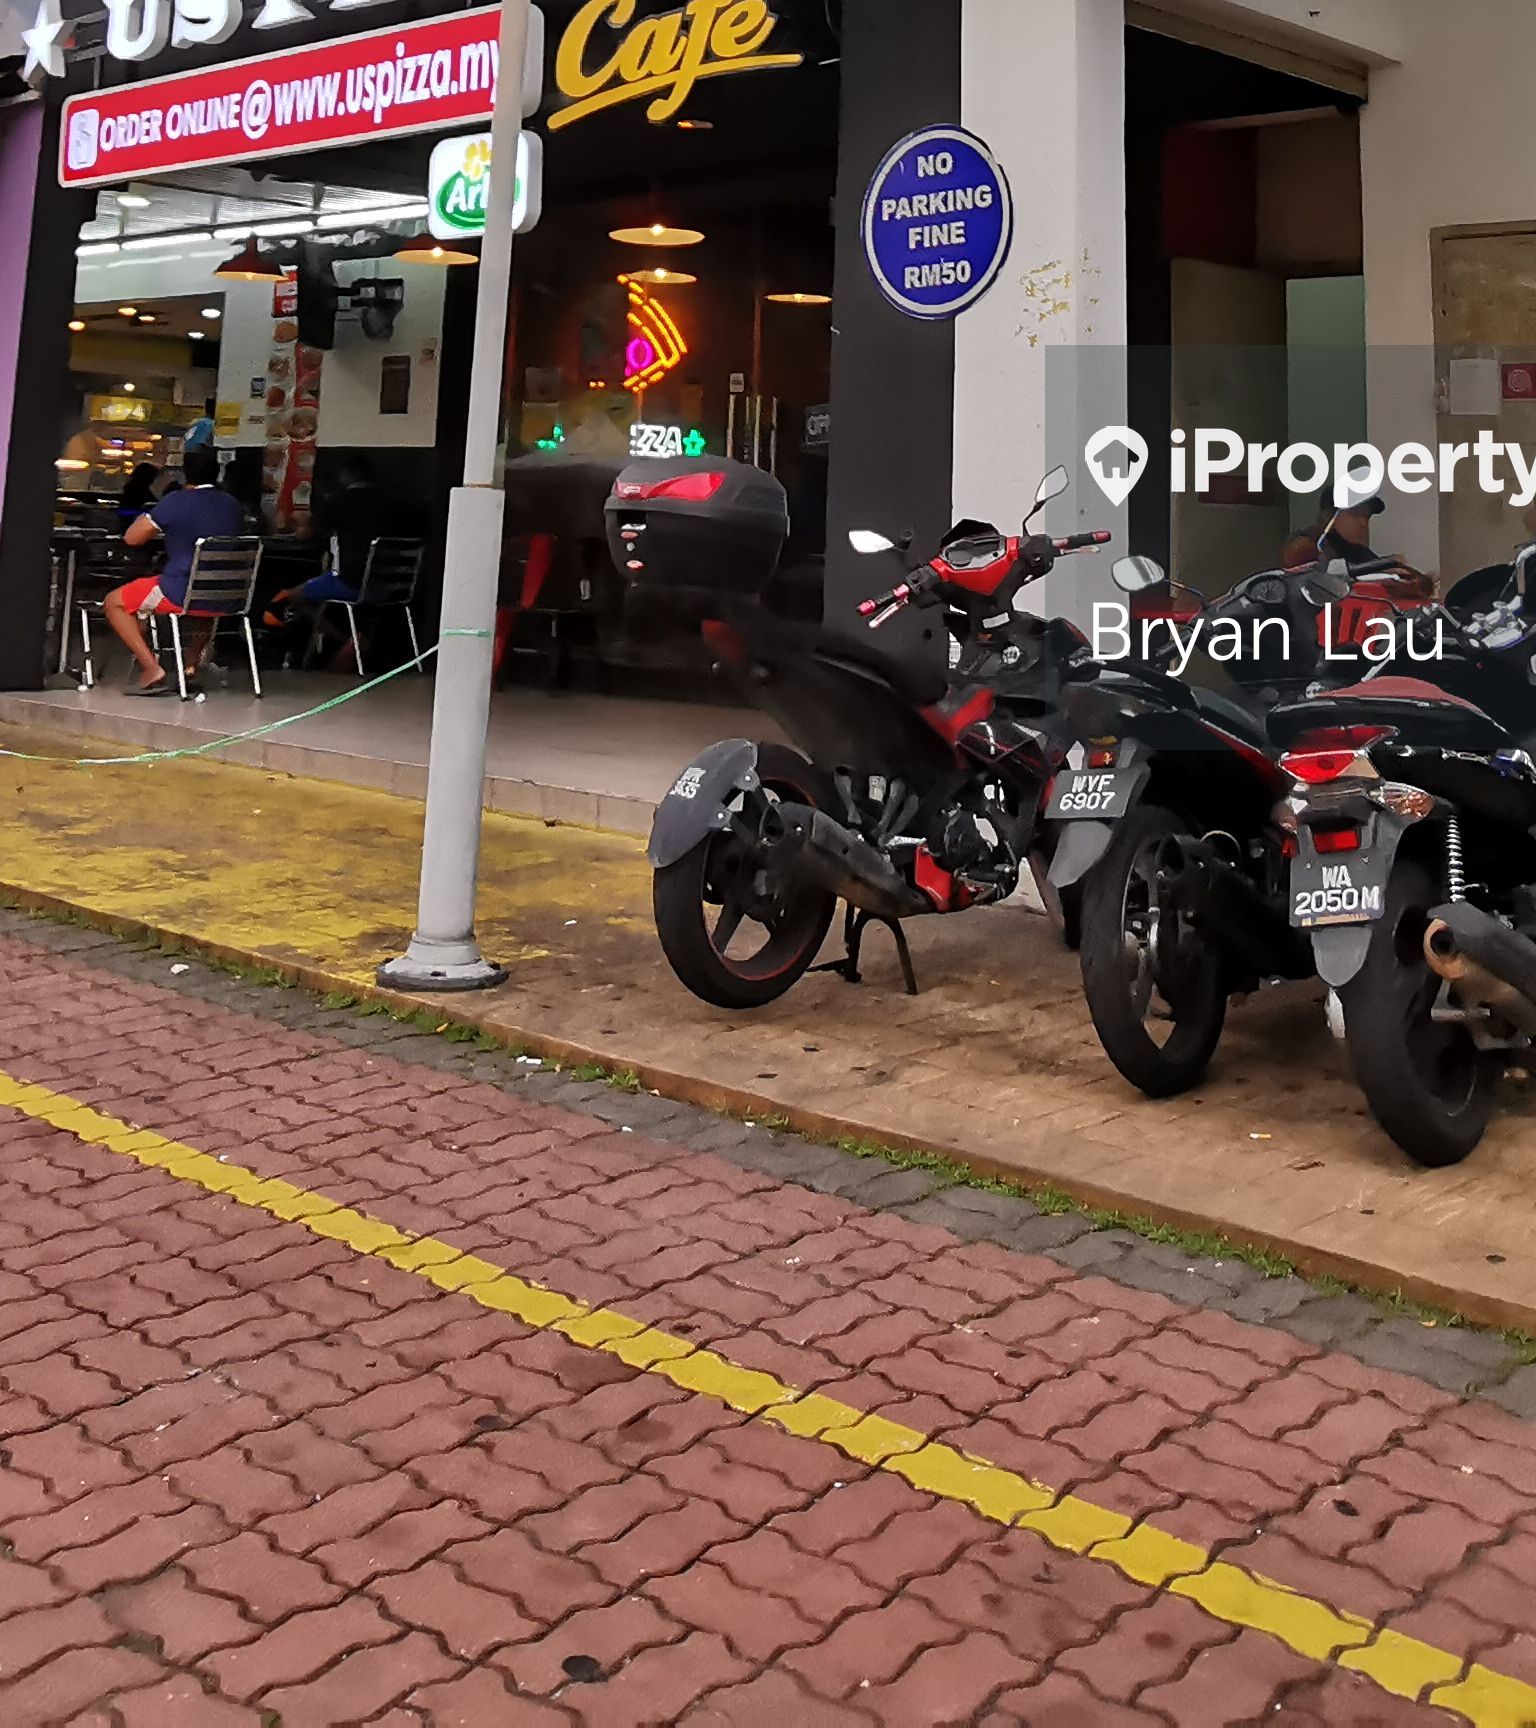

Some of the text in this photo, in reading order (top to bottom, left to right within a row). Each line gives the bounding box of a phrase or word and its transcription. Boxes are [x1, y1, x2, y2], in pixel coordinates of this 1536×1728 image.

[99, 108, 163, 152] ORDER
[916, 151, 954, 178] NO
[880, 184, 993, 222] PARKING
[907, 220, 967, 250] FINE
[903, 259, 972, 290] RM50
[1058, 791, 1116, 811] 6907
[1321, 864, 1353, 889] WA
[1293, 885, 1381, 916] 2050 M
